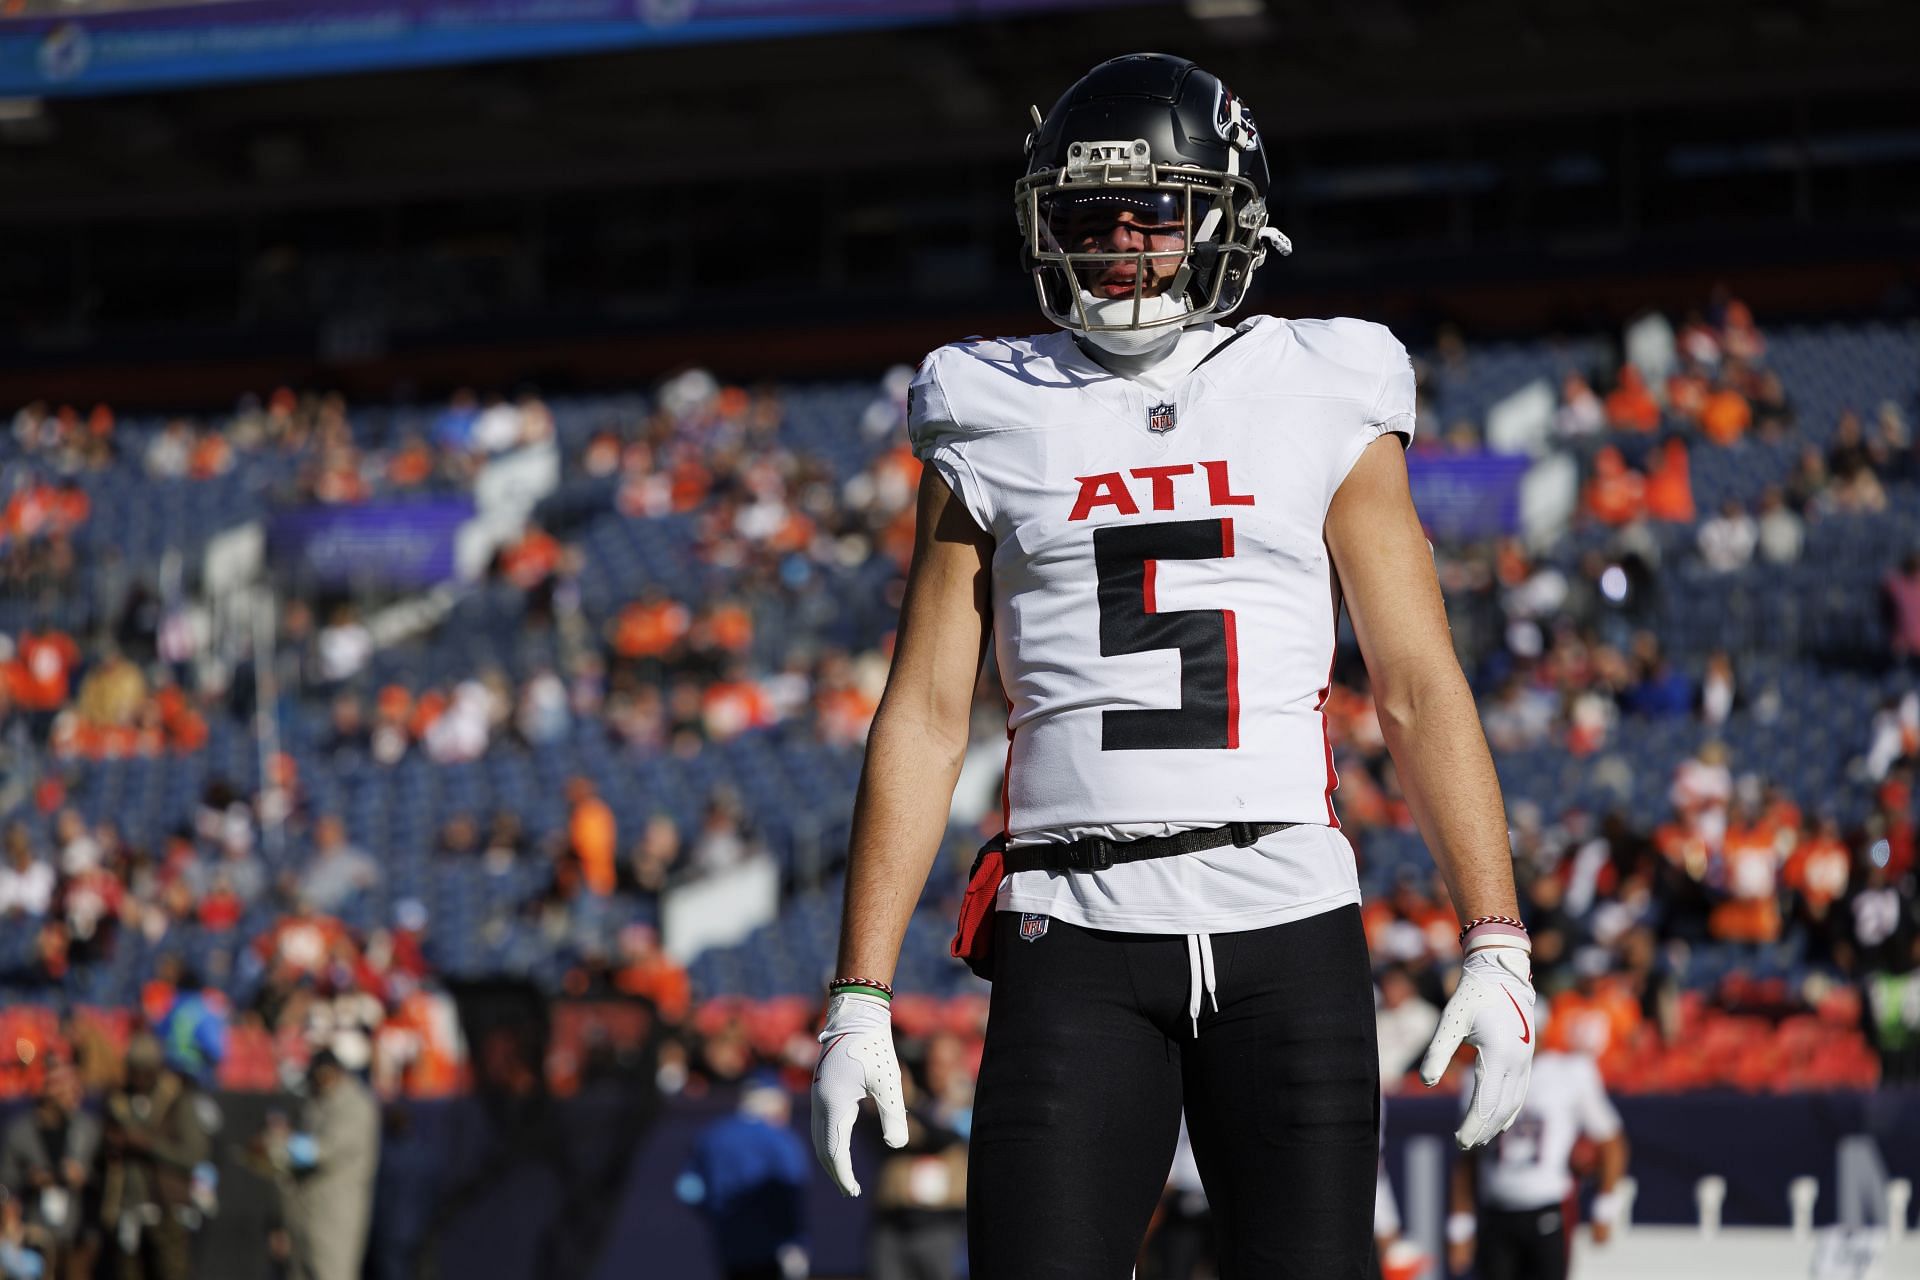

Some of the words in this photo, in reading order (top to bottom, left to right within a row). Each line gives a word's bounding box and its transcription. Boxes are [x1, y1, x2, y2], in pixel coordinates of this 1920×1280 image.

[1090, 147, 1130, 160] ATL
[1152, 415, 1173, 429] NFL
[1068, 460, 1255, 520] ATL
[1093, 517, 1240, 751] 5
[1023, 920, 1043, 935] NFL
